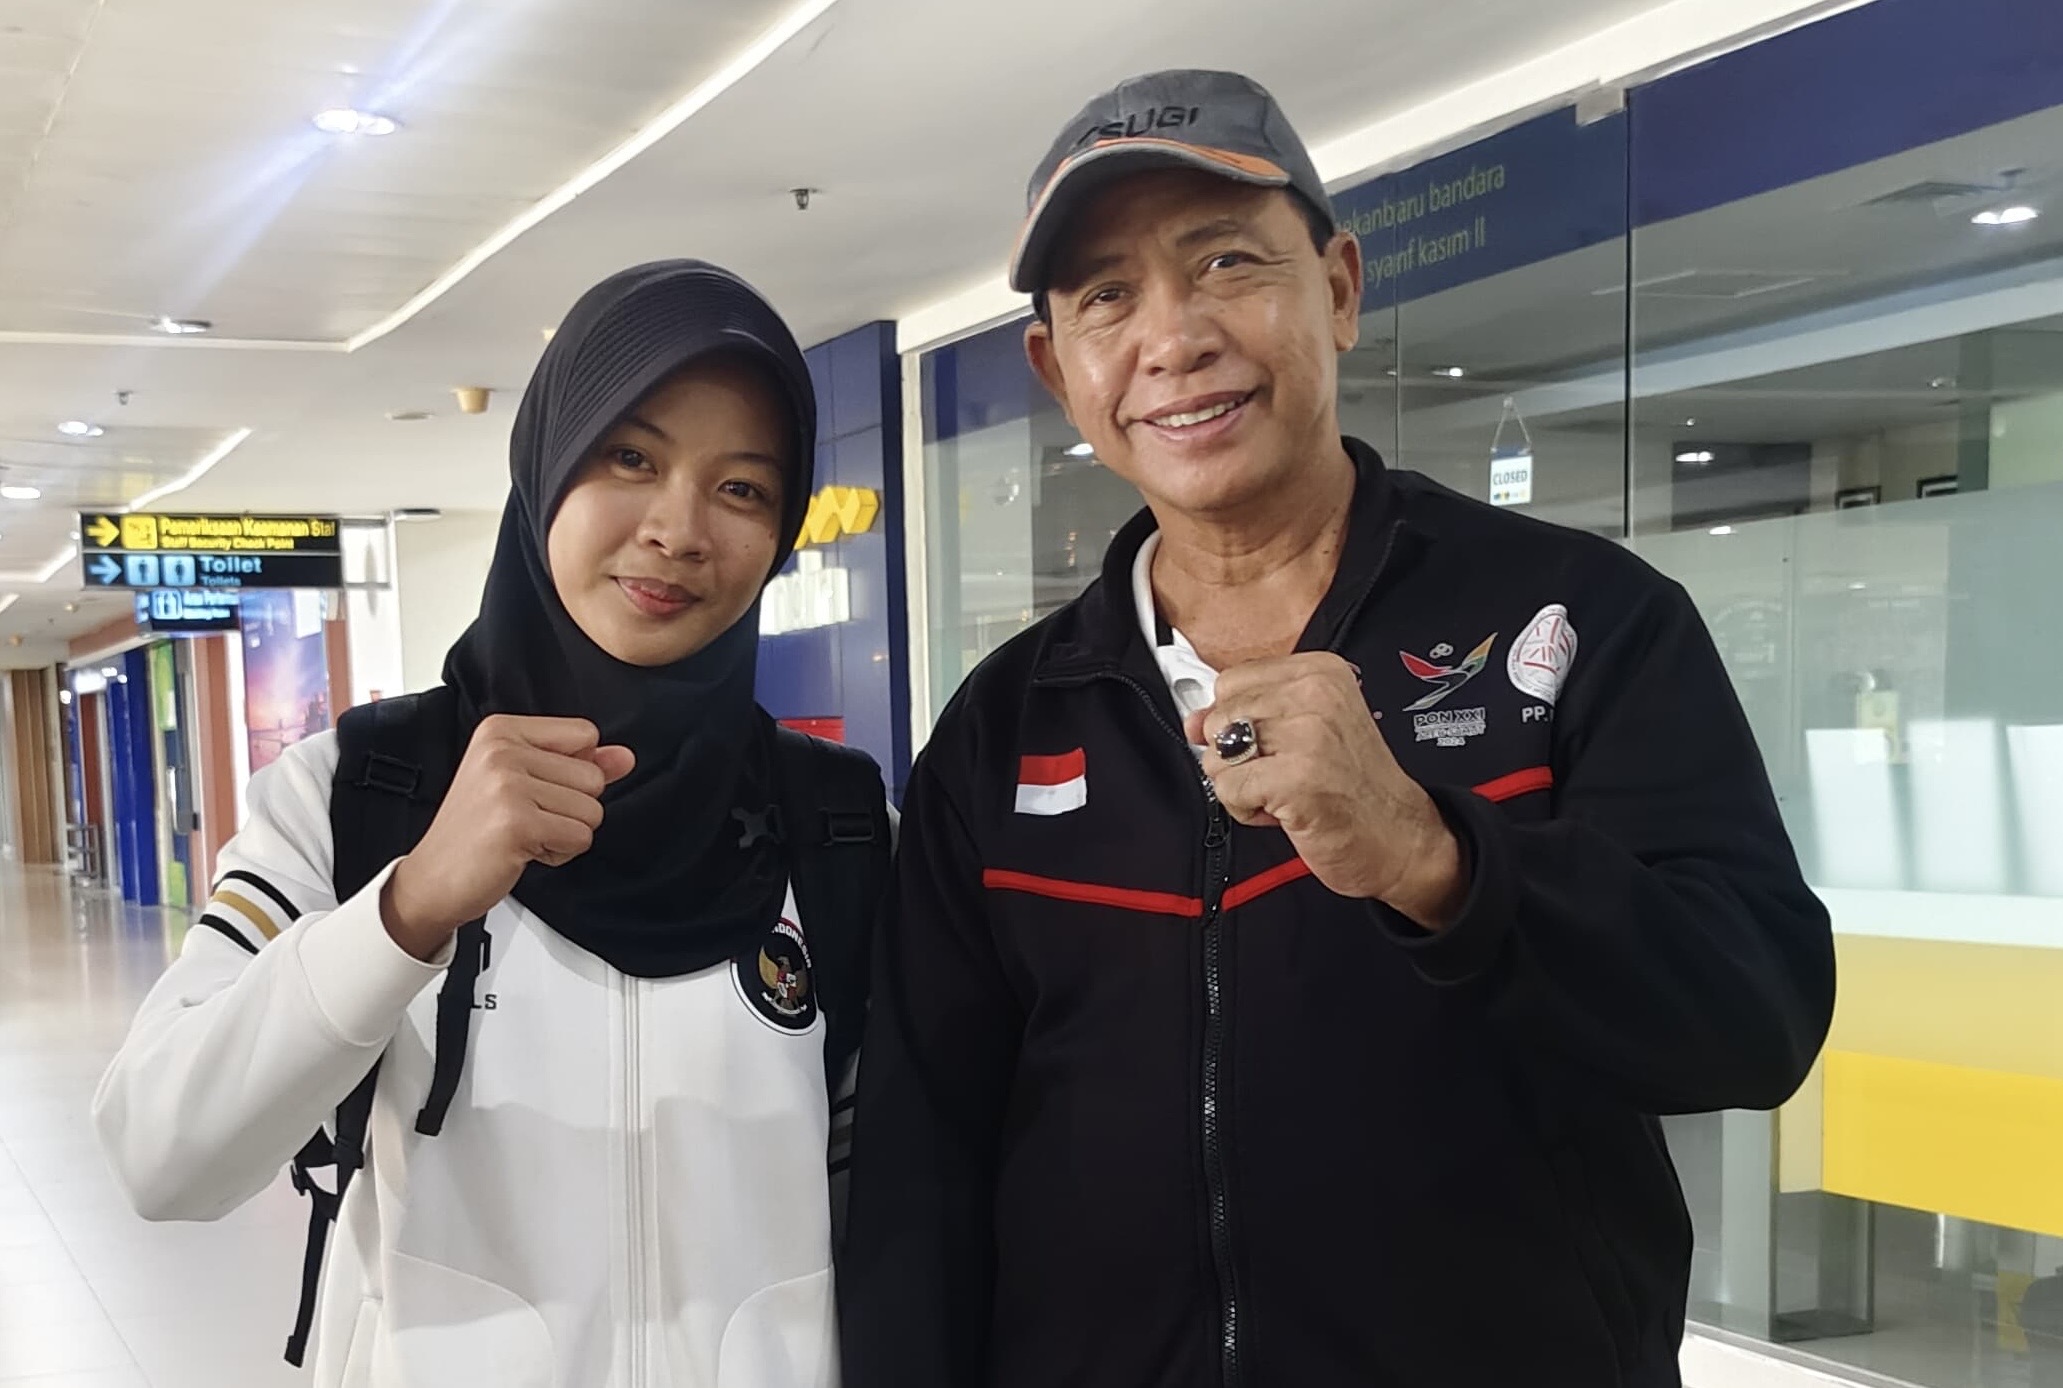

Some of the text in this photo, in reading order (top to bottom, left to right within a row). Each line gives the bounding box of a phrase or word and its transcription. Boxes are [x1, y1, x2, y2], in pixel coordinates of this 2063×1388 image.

[1429, 164, 1506, 213] bandara
[1366, 240, 1416, 289] syarif
[1417, 230, 1469, 267] kasim
[1492, 470, 1529, 486] CLOSED
[242, 516, 310, 537] Keamanan
[232, 537, 265, 549] Check
[266, 537, 295, 549] Point
[200, 556, 262, 573] Toilet
[201, 575, 241, 587] Toilets
[1414, 707, 1486, 728] PON XXI
[771, 922, 812, 969] NDONESIA
